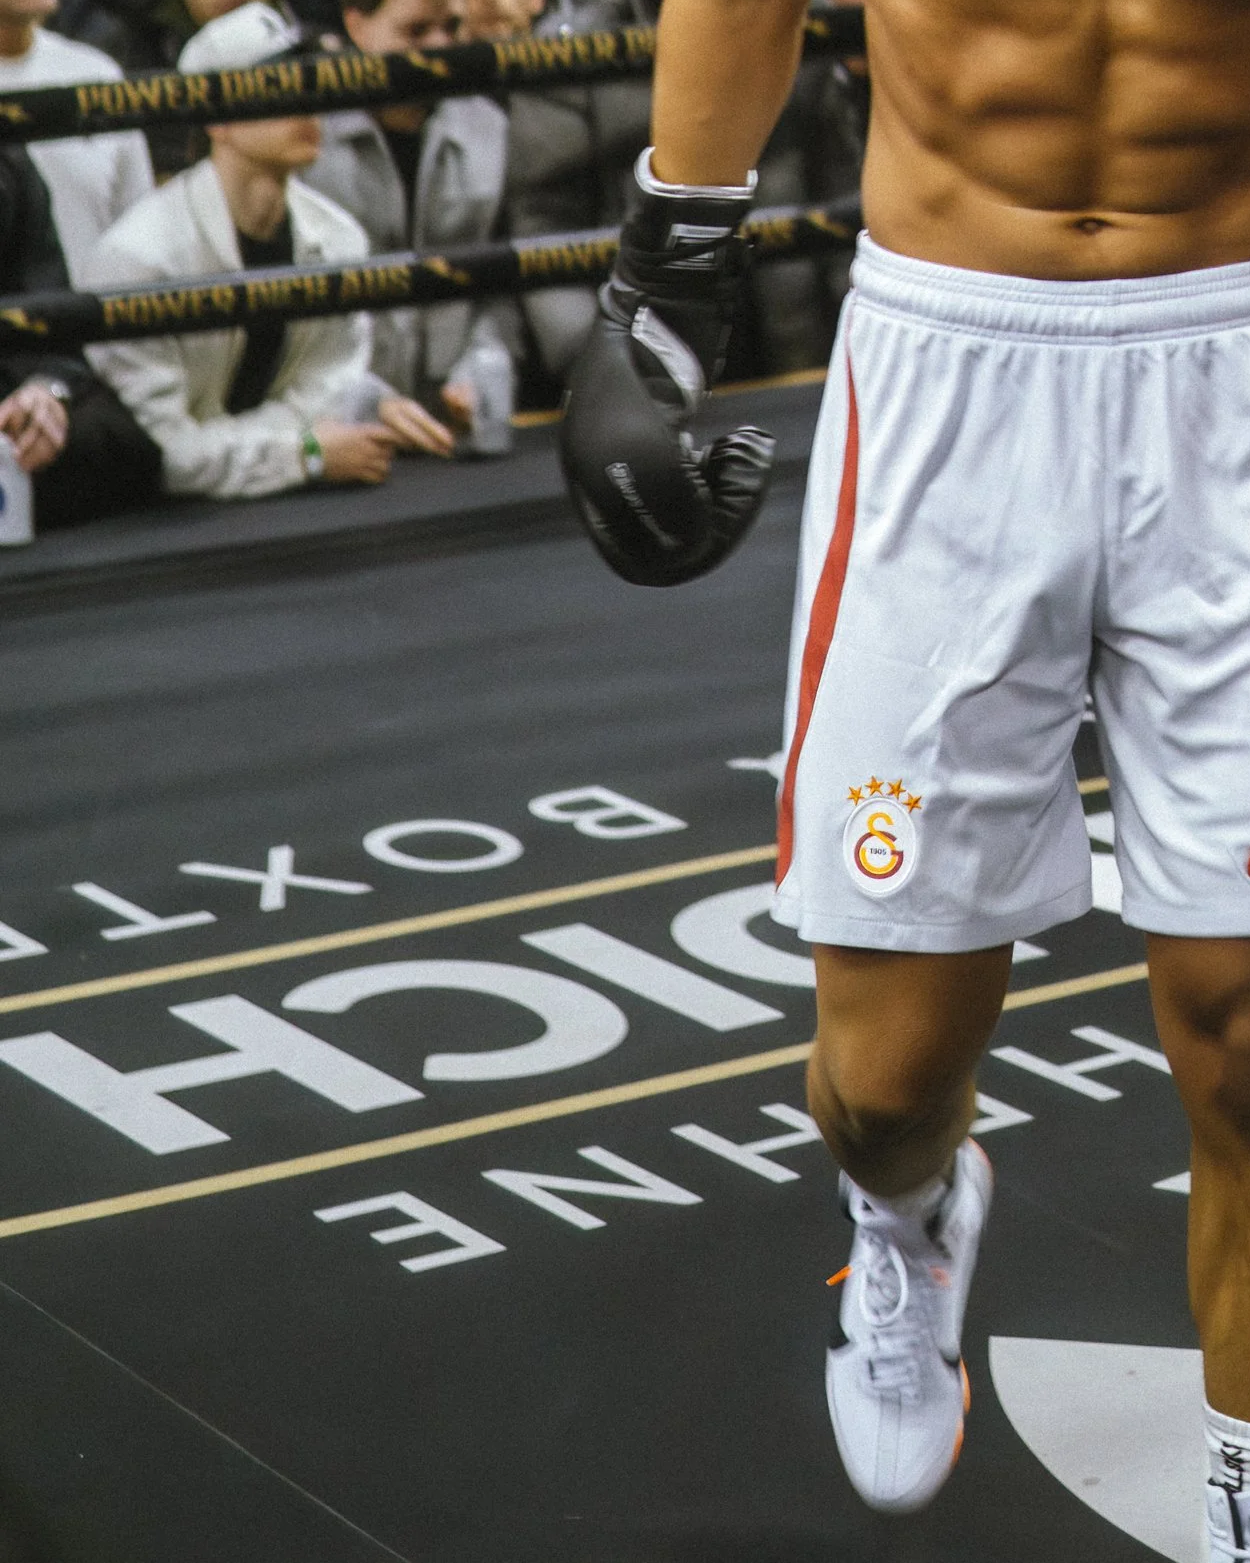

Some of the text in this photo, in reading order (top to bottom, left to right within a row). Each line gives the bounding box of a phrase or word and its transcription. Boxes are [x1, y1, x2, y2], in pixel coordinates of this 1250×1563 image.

[76, 51, 390, 118] POWER DICH AUS
[493, 32, 617, 76] POWER
[102, 263, 413, 328] POWER DICH AUS
[869, 847, 887, 856] 1905
[313, 1024, 1171, 1274] HHNE
